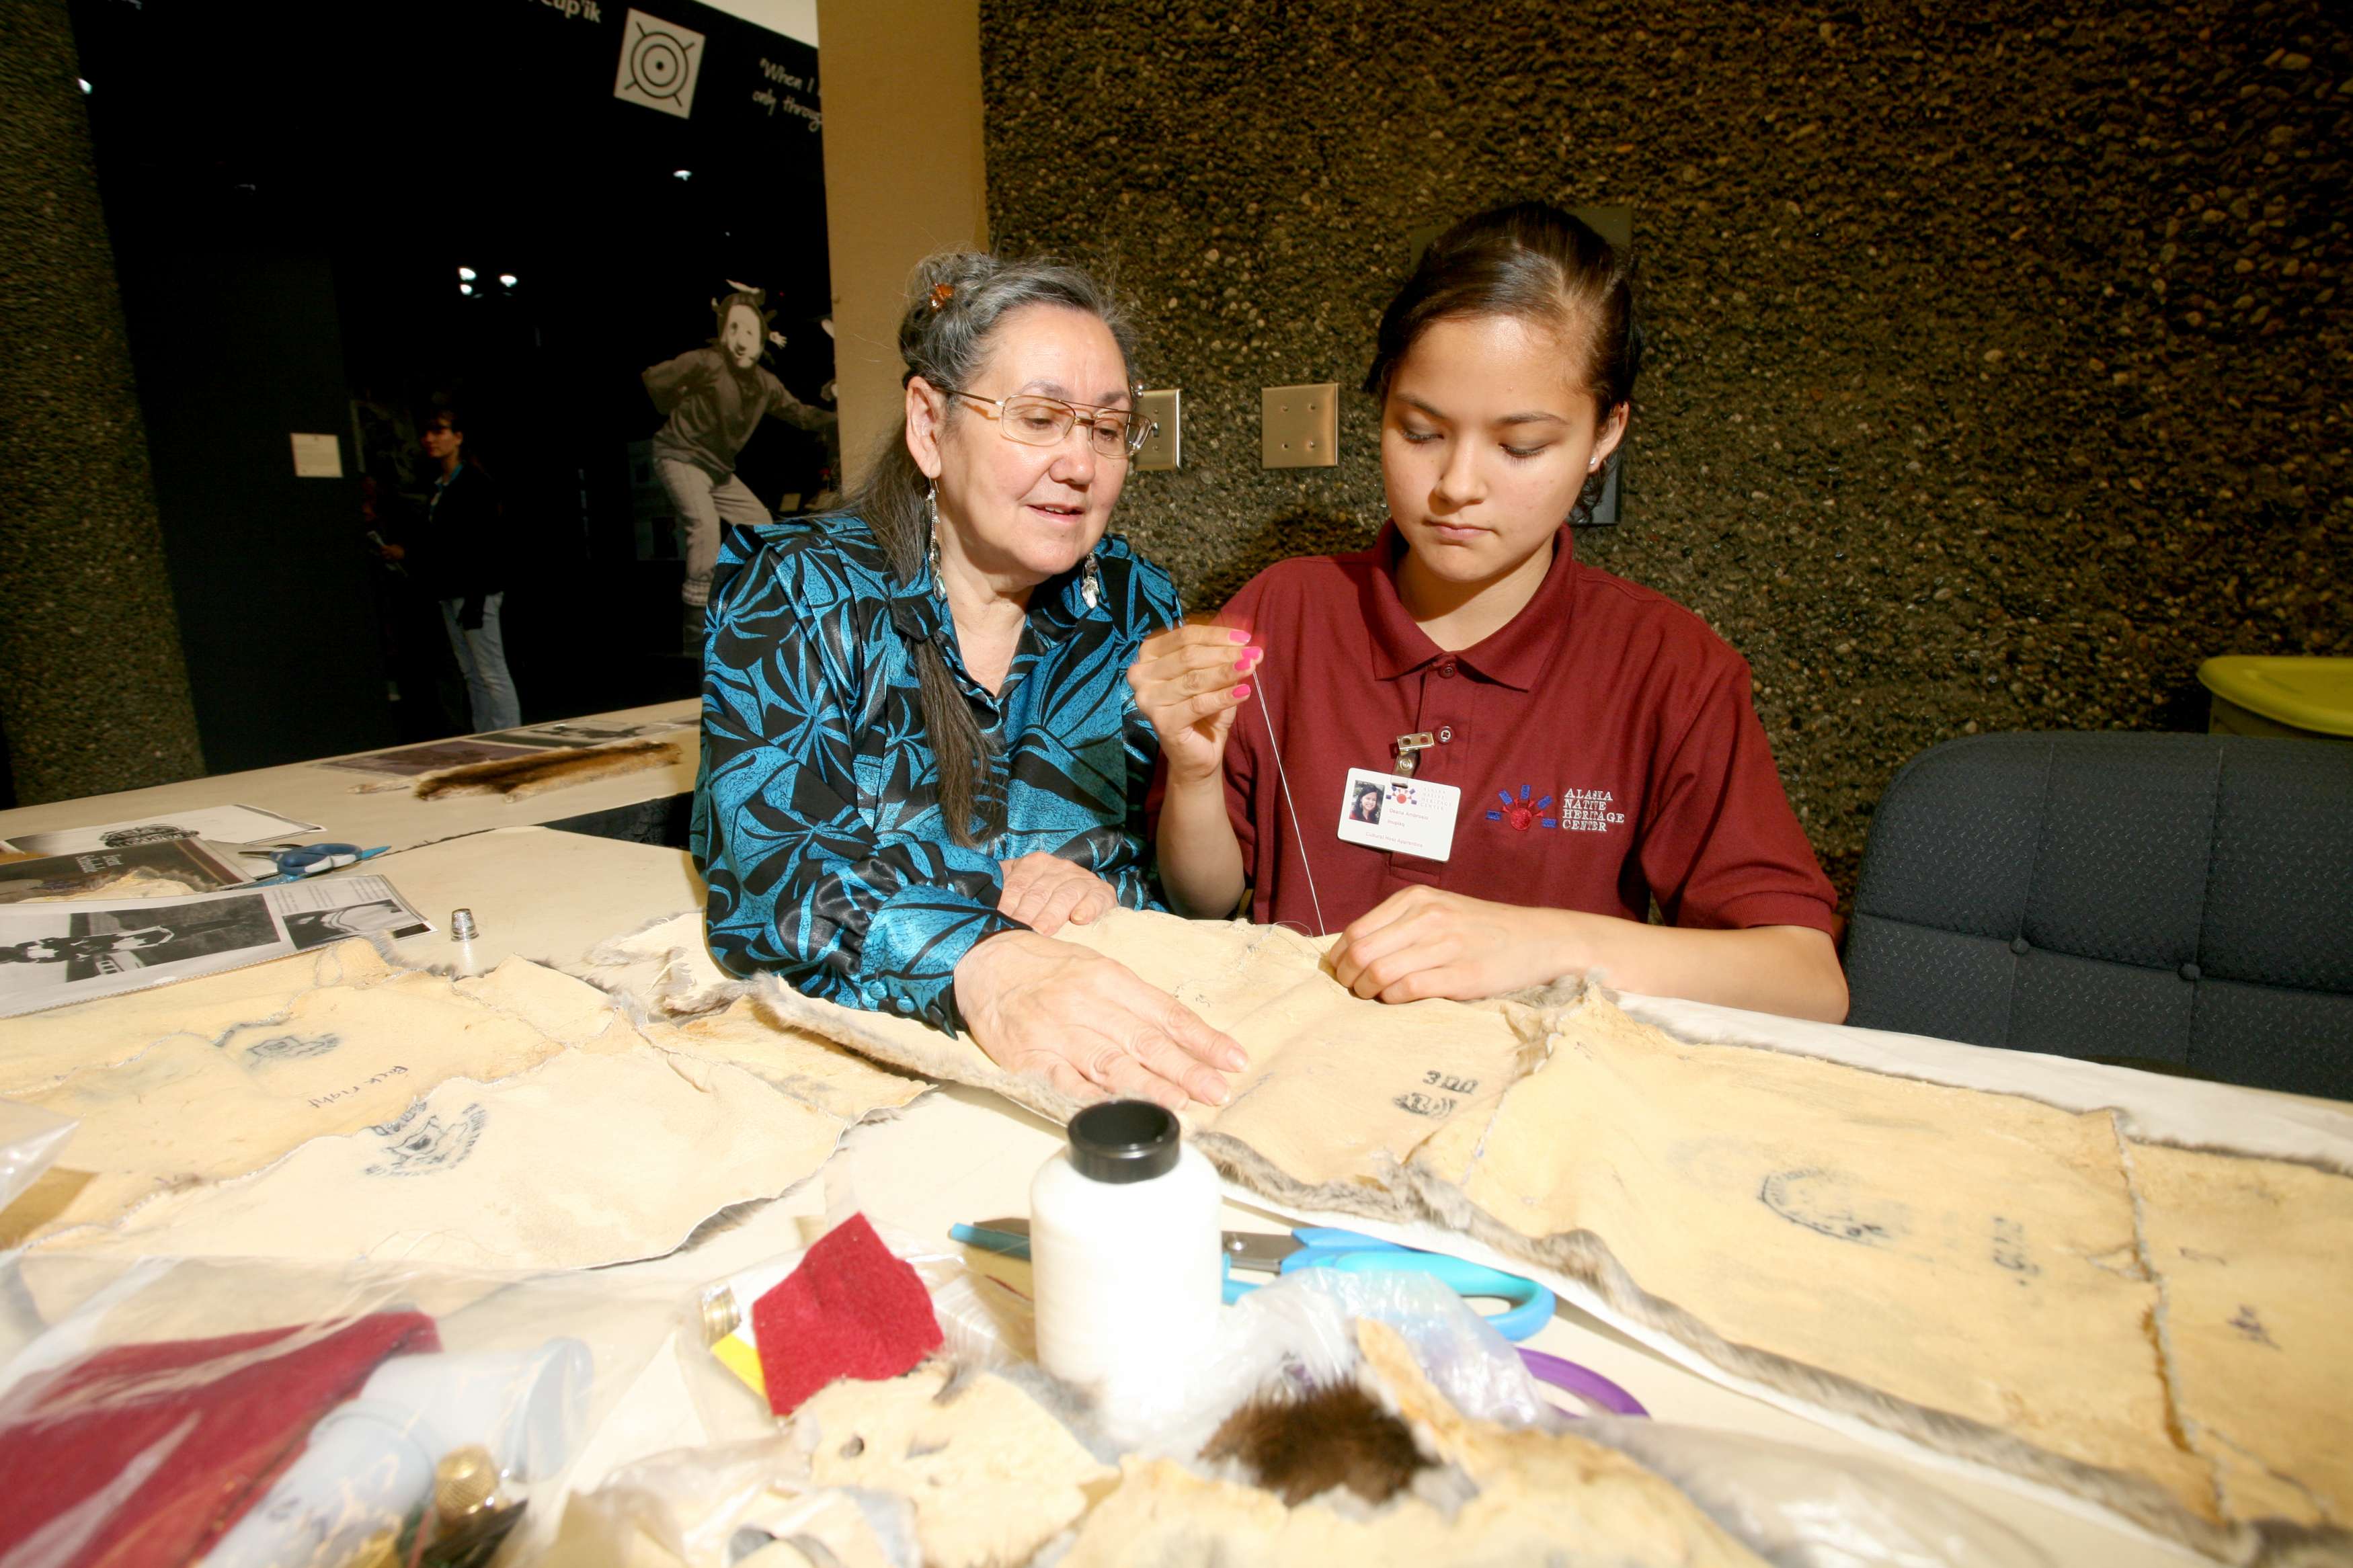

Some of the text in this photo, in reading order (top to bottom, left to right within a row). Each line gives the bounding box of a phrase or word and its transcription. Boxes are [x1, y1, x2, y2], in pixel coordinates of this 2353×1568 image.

[752, 89, 776, 116] only
[1564, 788, 1613, 801] ALASKA
[1563, 798, 1607, 811] NATIVE
[1562, 809, 1625, 823] HERITAGE
[1562, 819, 1607, 831] CENTER
[307, 1085, 360, 1108] right
